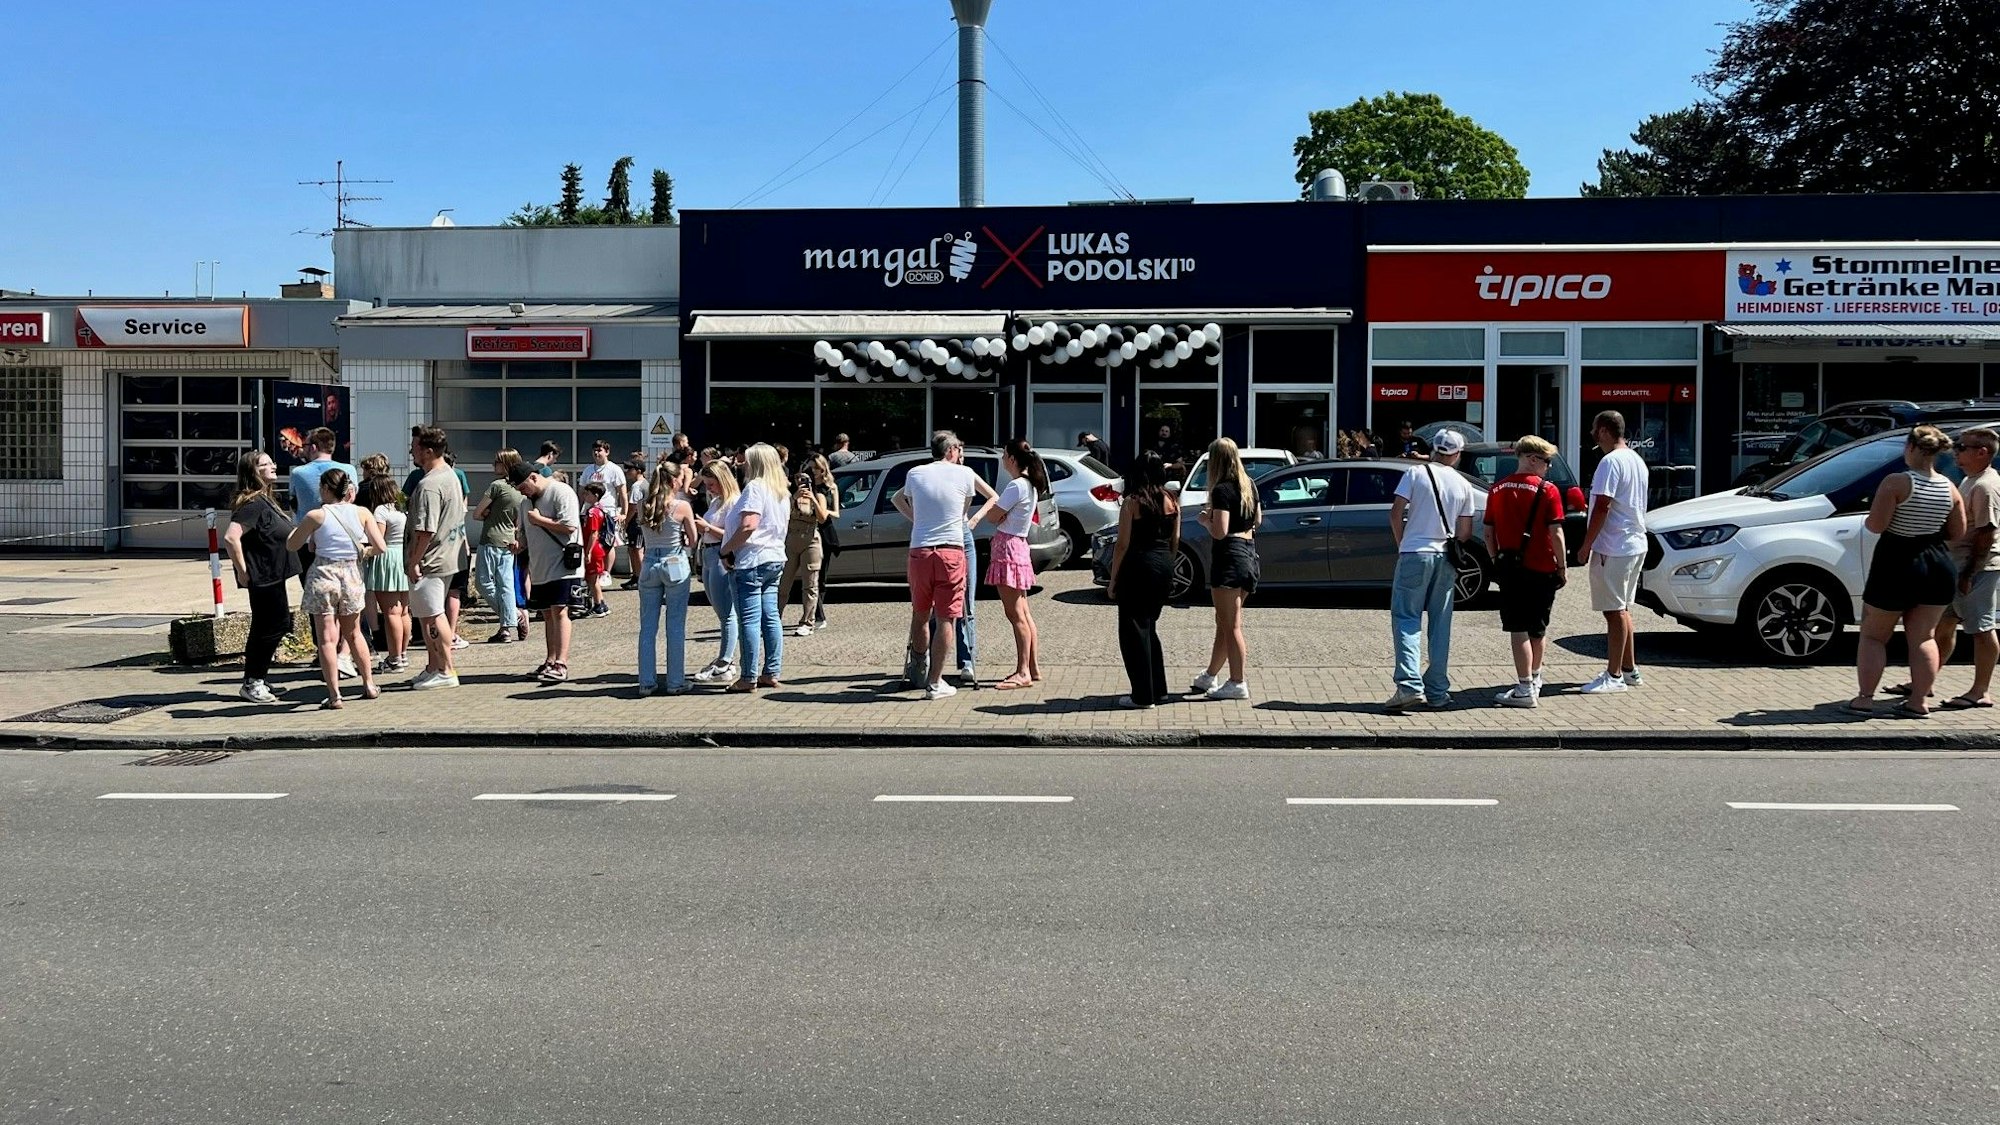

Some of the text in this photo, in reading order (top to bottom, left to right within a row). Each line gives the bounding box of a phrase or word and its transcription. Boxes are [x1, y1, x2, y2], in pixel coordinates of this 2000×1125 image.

[1048, 232, 1130, 255] LUKAS
[802, 237, 943, 288] mangal
[908, 270, 941, 283] DÖNER
[1475, 265, 1612, 307] tipico
[1783, 276, 1940, 296] Getränke
[1737, 302, 1824, 313] HEIMDIENST
[1834, 302, 1941, 313] LIEFERSERVICE
[1951, 302, 1980, 313] TEL.
[0, 322, 38, 337] ren
[124, 318, 207, 335] Service
[474, 337, 519, 351] Reifen
[529, 337, 581, 351] Service
[1380, 387, 1409, 397] tipico
[1624, 437, 1655, 449] ipico
